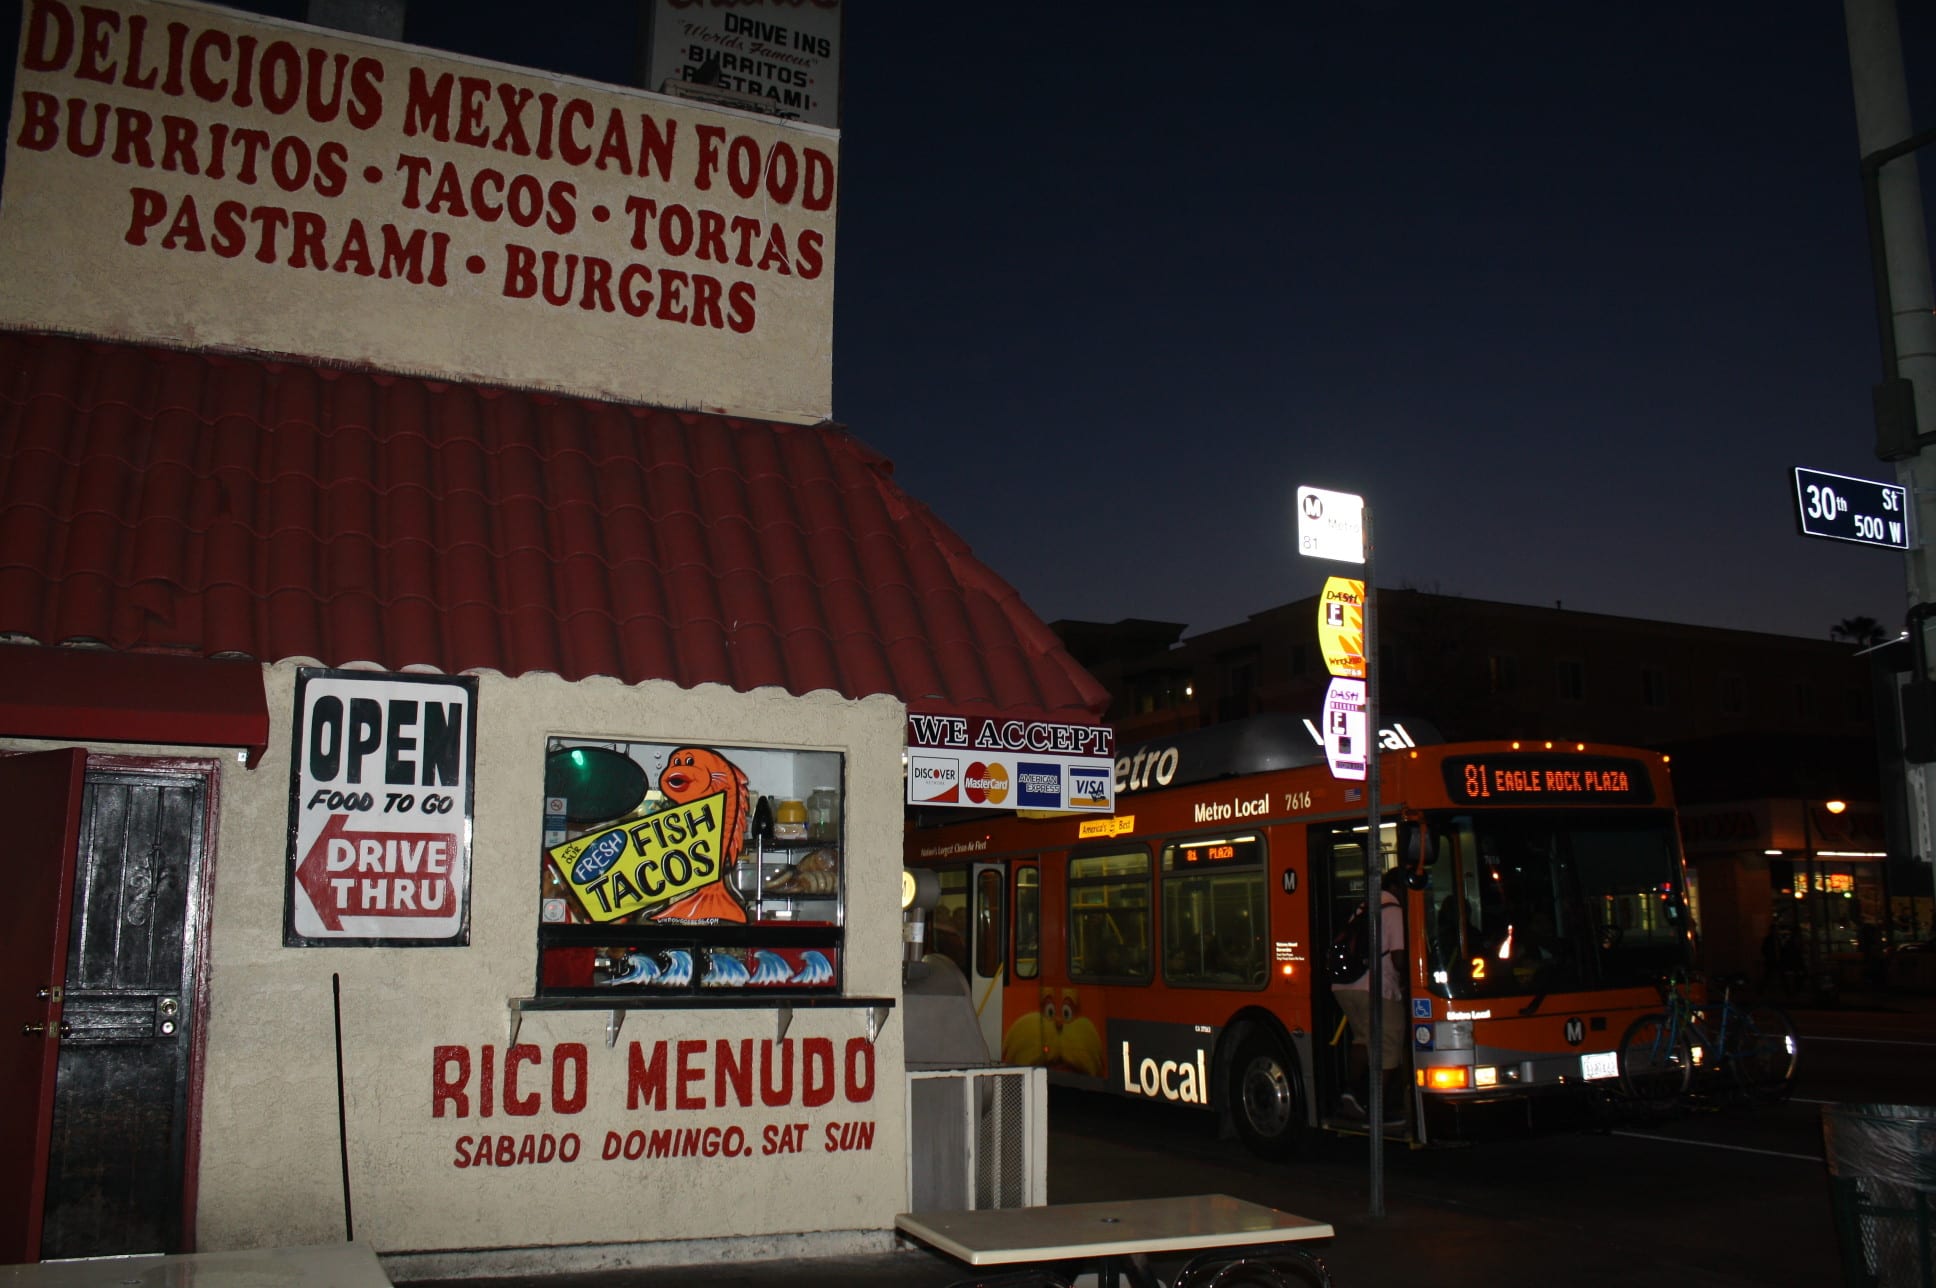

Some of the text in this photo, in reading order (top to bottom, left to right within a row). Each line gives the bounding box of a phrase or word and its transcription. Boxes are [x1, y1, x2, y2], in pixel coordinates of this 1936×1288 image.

[725, 12, 831, 58] DRIVE INS
[682, 65, 810, 110] PSTRAMI
[23, 0, 834, 211] DELICIOUS MEXICAN FOOD
[17, 91, 823, 280] BURRITOS TACOS TORTAS
[125, 187, 756, 333] PASTRAMI BURGERS
[1807, 485, 1898, 520] 30th St
[1304, 535, 1317, 549] 81
[1854, 515, 1901, 543] 500 W
[1327, 590, 1358, 604] DASH
[1330, 689, 1358, 701] DASH
[310, 695, 462, 787] OPEN
[909, 714, 1112, 756] WE ACCEPT
[965, 777, 1008, 791] MasterCard
[1019, 773, 1058, 785] AMERICAN
[1114, 746, 1179, 793] etro
[1464, 764, 1629, 797] 81 EAGLE ROCK PLAZA
[308, 789, 453, 814] FOOD TO GO
[1025, 783, 1061, 794] EXPRESS
[1076, 780, 1105, 796] VISA
[1285, 791, 1311, 811] 7616
[1194, 793, 1269, 823] Metro Local
[629, 804, 716, 857] FISH
[326, 838, 447, 873] DRIVE
[561, 844, 574, 860] TRY
[566, 846, 581, 864] OUR
[576, 833, 622, 881] FRESH
[1186, 846, 1234, 861] 81 PLAZA
[585, 840, 715, 913] TACOS
[331, 878, 444, 910] THRU
[1472, 958, 1485, 978] 2
[1567, 1024, 1583, 1042] M
[433, 1037, 875, 1118] RICO MENUDO
[1122, 1041, 1208, 1104] Local
[454, 1133, 580, 1168] SABADO
[762, 1124, 809, 1155] SAT
[825, 1122, 875, 1153] SUN
